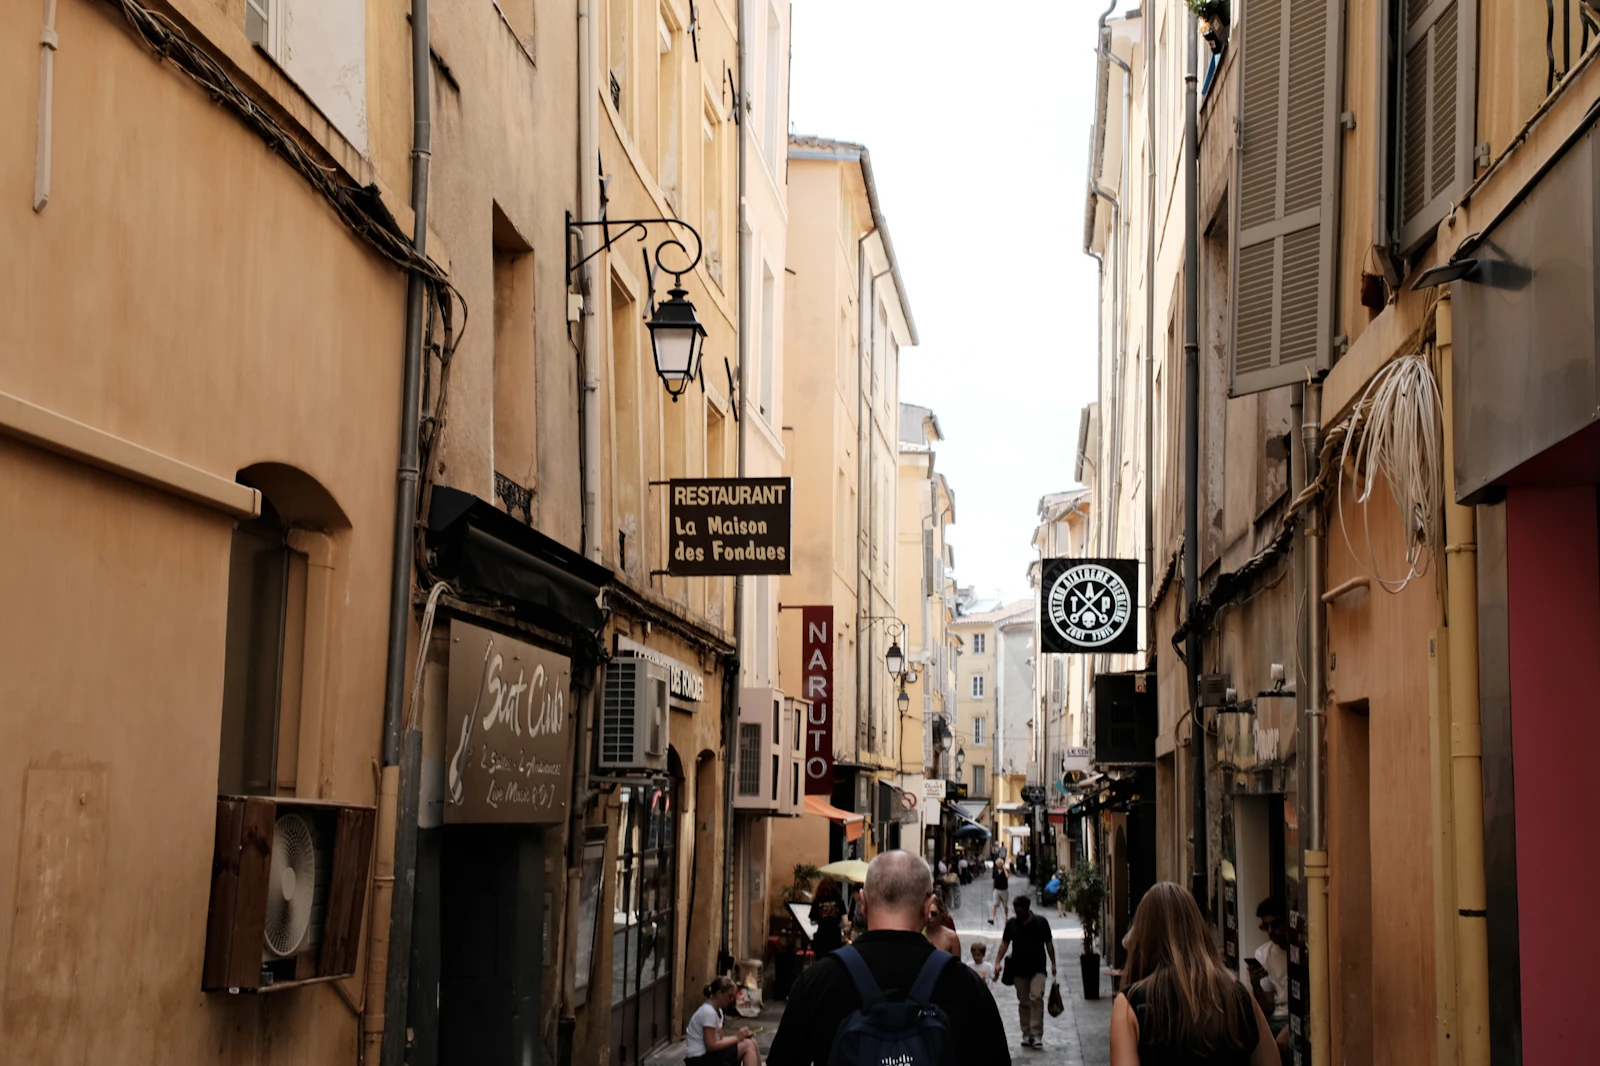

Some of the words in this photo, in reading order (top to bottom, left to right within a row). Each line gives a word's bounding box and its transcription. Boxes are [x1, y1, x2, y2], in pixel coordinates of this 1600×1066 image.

[674, 485, 786, 506] RESTAURANT
[674, 516, 697, 536] La
[707, 515, 768, 536] Maison
[674, 540, 705, 562] des
[712, 540, 786, 562] Fondues
[1052, 585, 1067, 624] TATTOO
[1062, 568, 1111, 590] AIXTREME
[1107, 577, 1128, 624] PIERCING
[1065, 625, 1086, 641] 1997
[1090, 625, 1115, 642] SINCE
[482, 654, 527, 737] Scat
[527, 664, 563, 738] Club
[806, 621, 828, 779] NARUTO
[486, 777, 505, 809] Live
[505, 780, 530, 803] Music
